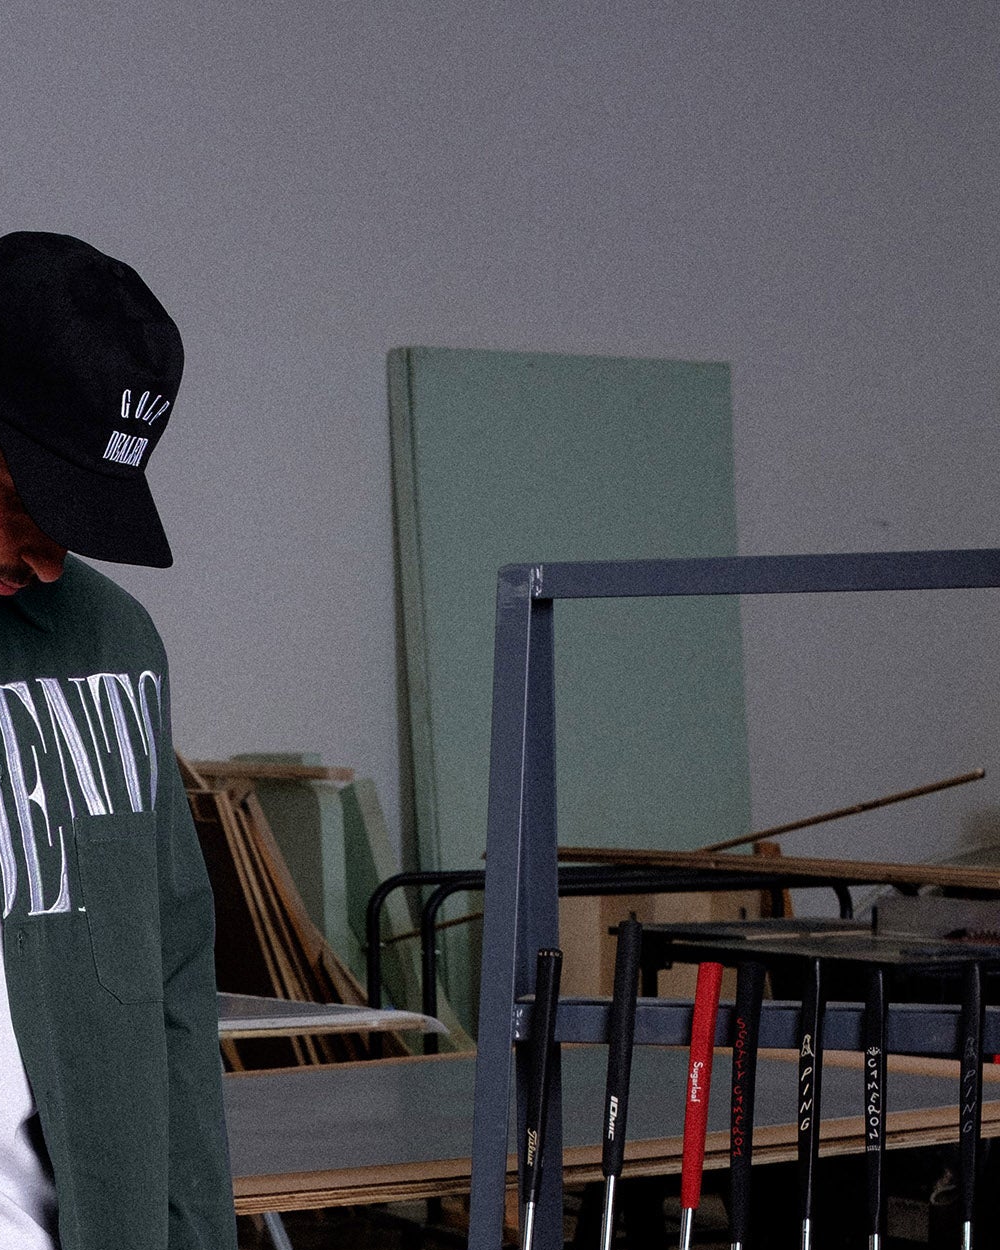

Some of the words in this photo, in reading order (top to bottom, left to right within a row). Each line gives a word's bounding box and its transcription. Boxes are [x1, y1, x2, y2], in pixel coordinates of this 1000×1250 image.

[690, 1061, 704, 1103] Sugarloaf
[799, 1066, 813, 1131] PING
[867, 1058, 880, 1140] CAMERON
[962, 1068, 976, 1133] PING
